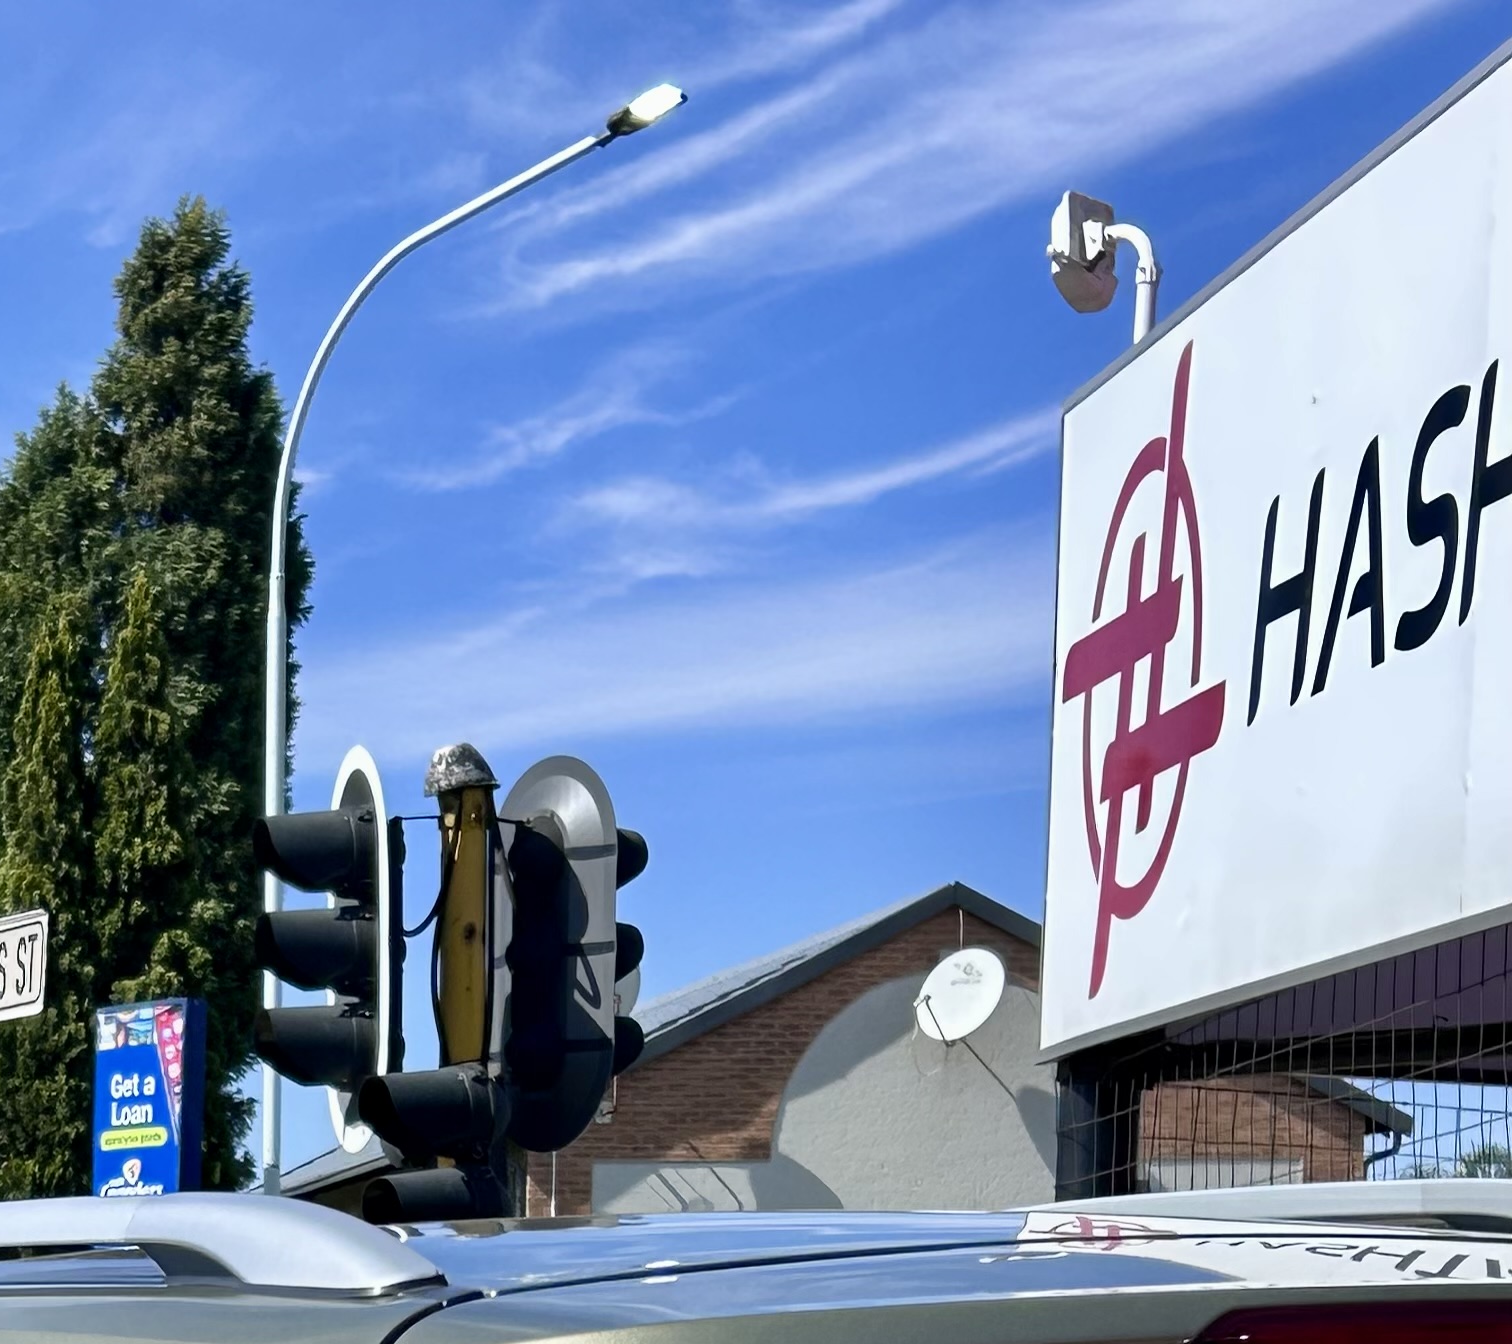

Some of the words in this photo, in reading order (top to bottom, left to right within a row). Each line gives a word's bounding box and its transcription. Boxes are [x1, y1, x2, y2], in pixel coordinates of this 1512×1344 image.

[16, 933, 38, 996] ST
[110, 1074, 140, 1099] Get
[143, 1075, 156, 1096] a
[110, 1102, 153, 1127] Loan
